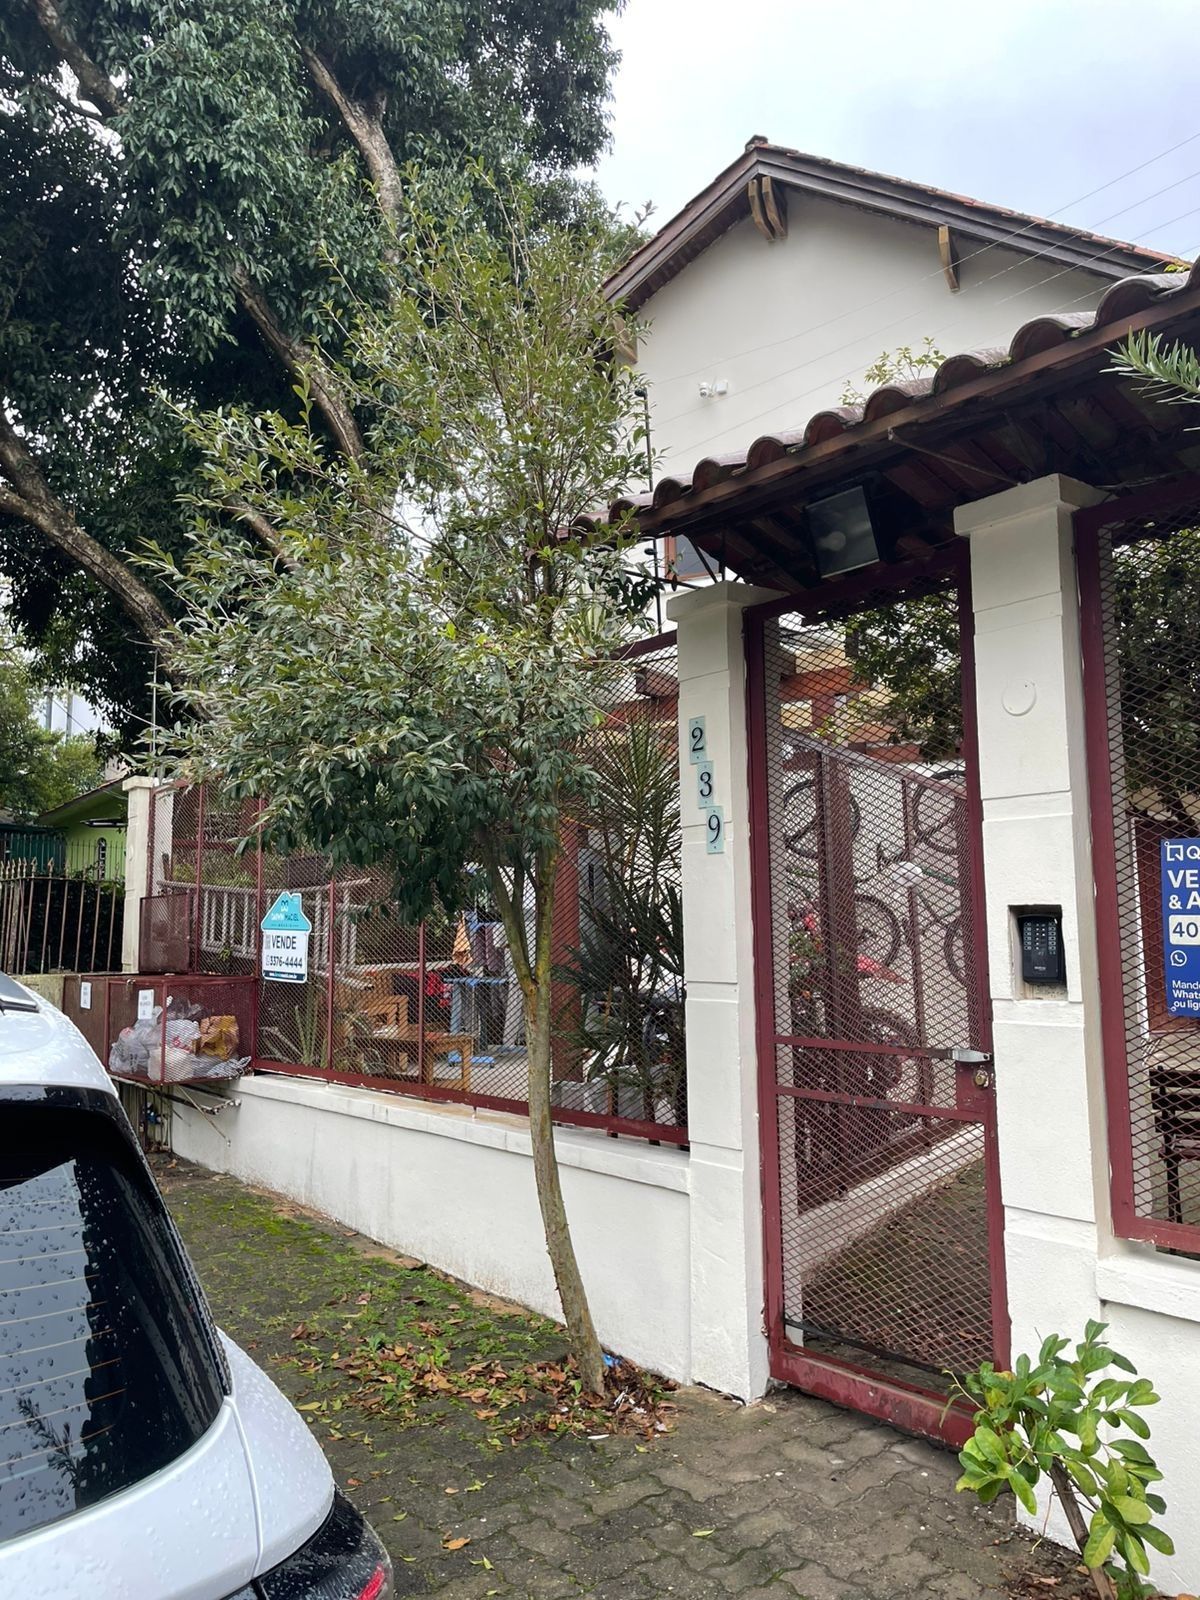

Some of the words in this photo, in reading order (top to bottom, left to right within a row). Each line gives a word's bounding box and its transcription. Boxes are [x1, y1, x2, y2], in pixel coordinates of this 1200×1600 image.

[1168, 894, 1183, 910] &
[271, 935, 297, 950] VENDE
[270, 955, 302, 968] 3376-4444
[1171, 979, 1200, 990] Mand
[1173, 1000, 1186, 1008] ou
